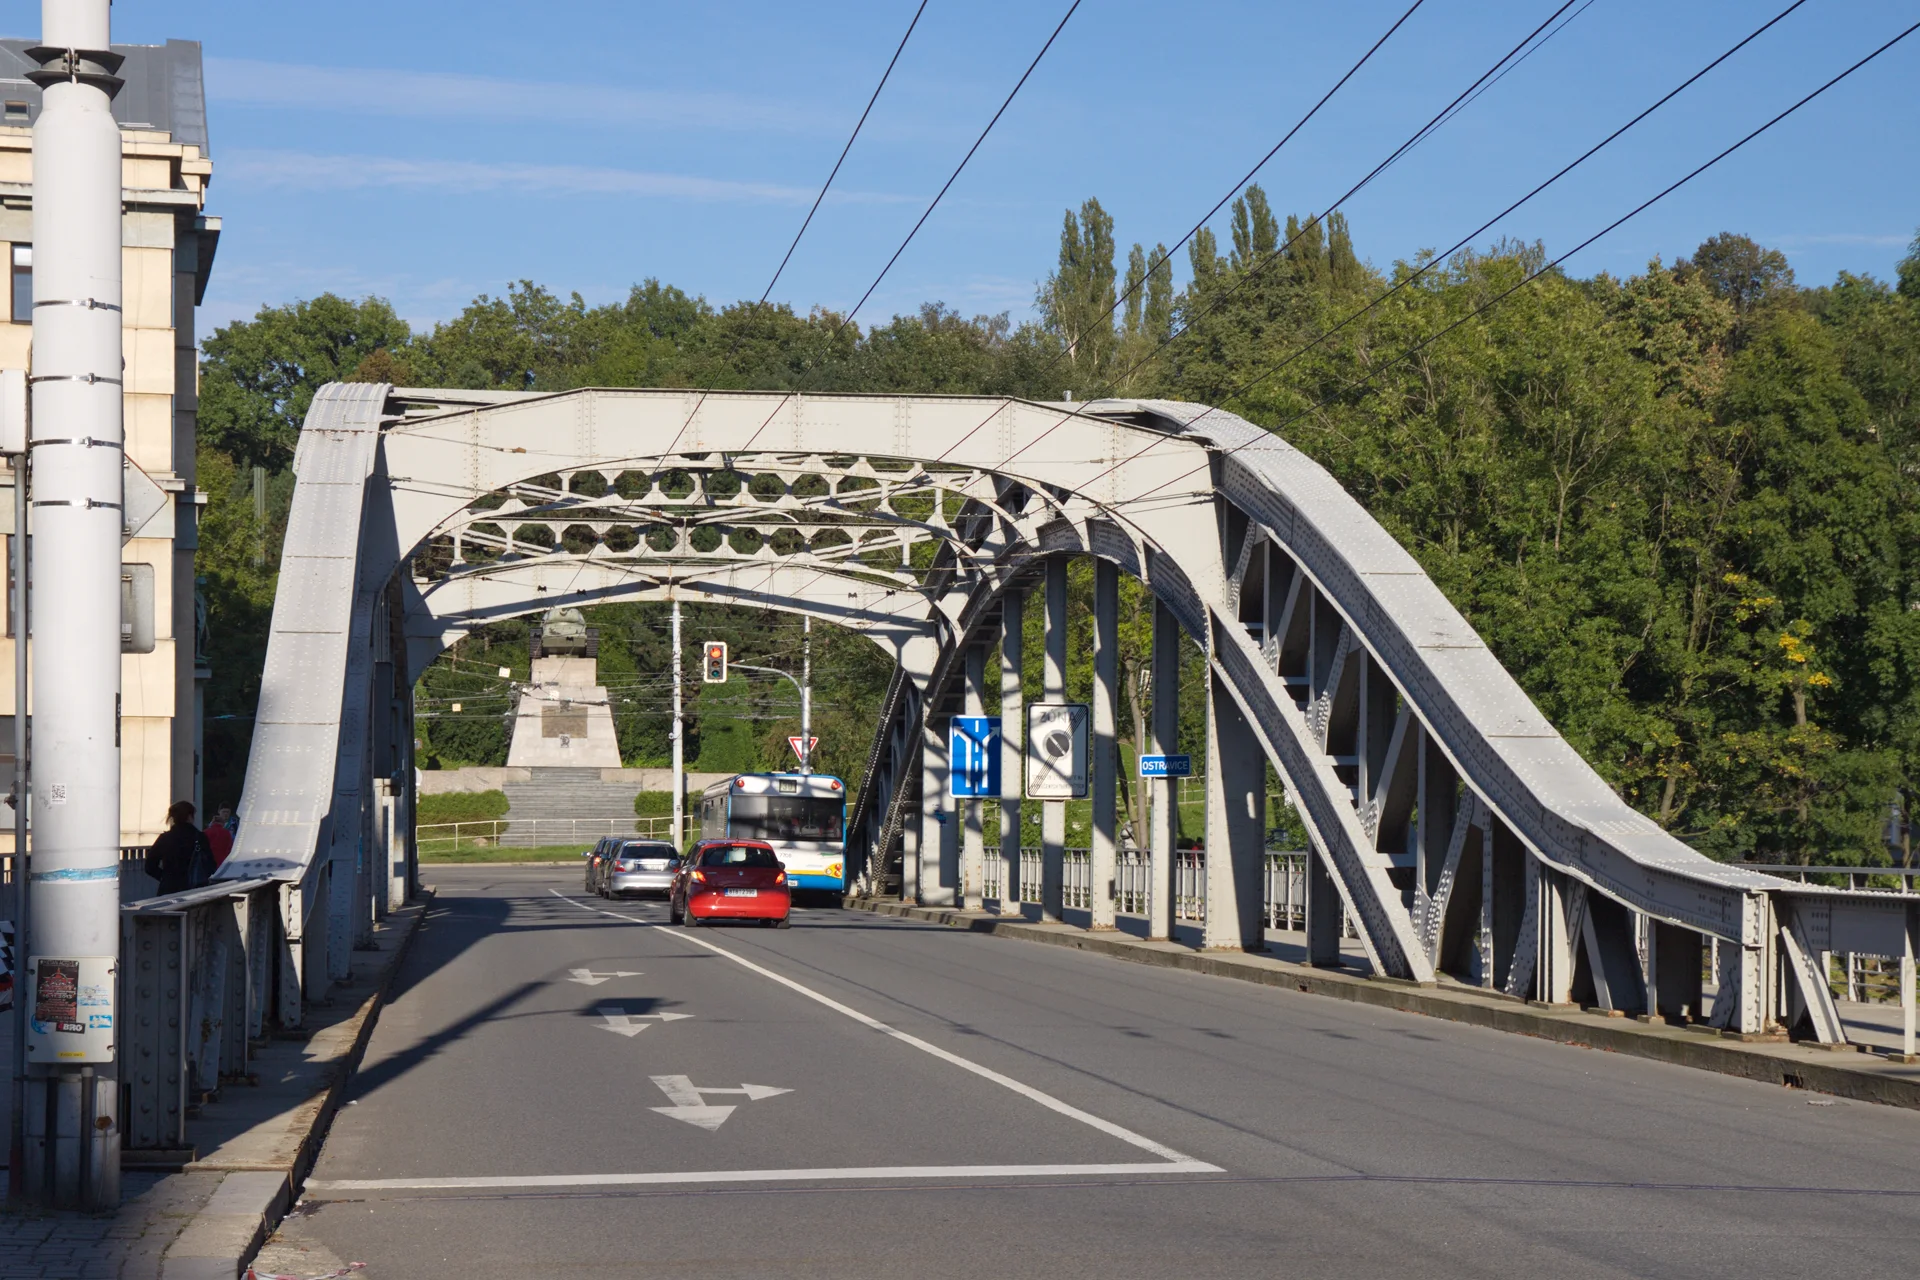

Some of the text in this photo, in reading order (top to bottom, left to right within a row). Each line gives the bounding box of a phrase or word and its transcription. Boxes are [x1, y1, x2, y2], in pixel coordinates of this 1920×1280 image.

[1039, 709, 1077, 723] ZÓNA
[1142, 761, 1188, 771] OSTRAVICE
[58, 1023, 83, 1032] 4BRO
